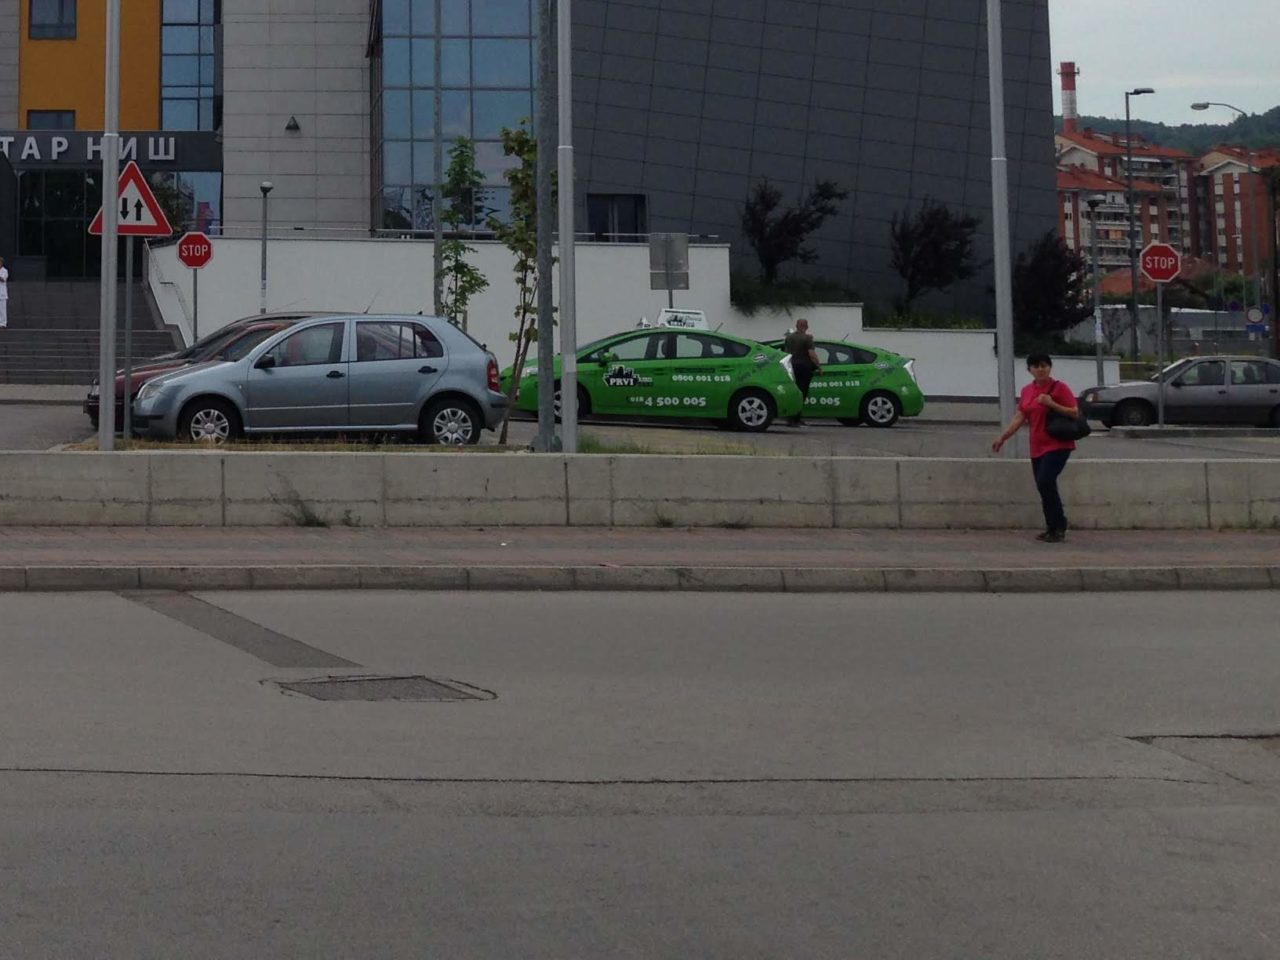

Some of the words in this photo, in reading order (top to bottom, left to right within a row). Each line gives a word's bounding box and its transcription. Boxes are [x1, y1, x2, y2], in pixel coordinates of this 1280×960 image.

[86, 136, 176, 161] НИШ
[182, 244, 209, 257] STOP
[1145, 256, 1176, 269] STOP
[609, 377, 635, 386] PRVI
[672, 374, 694, 382] 0800
[644, 396, 653, 407] 4
[656, 396, 680, 407] 500
[683, 396, 707, 407] 005
[819, 396, 841, 407] 005
